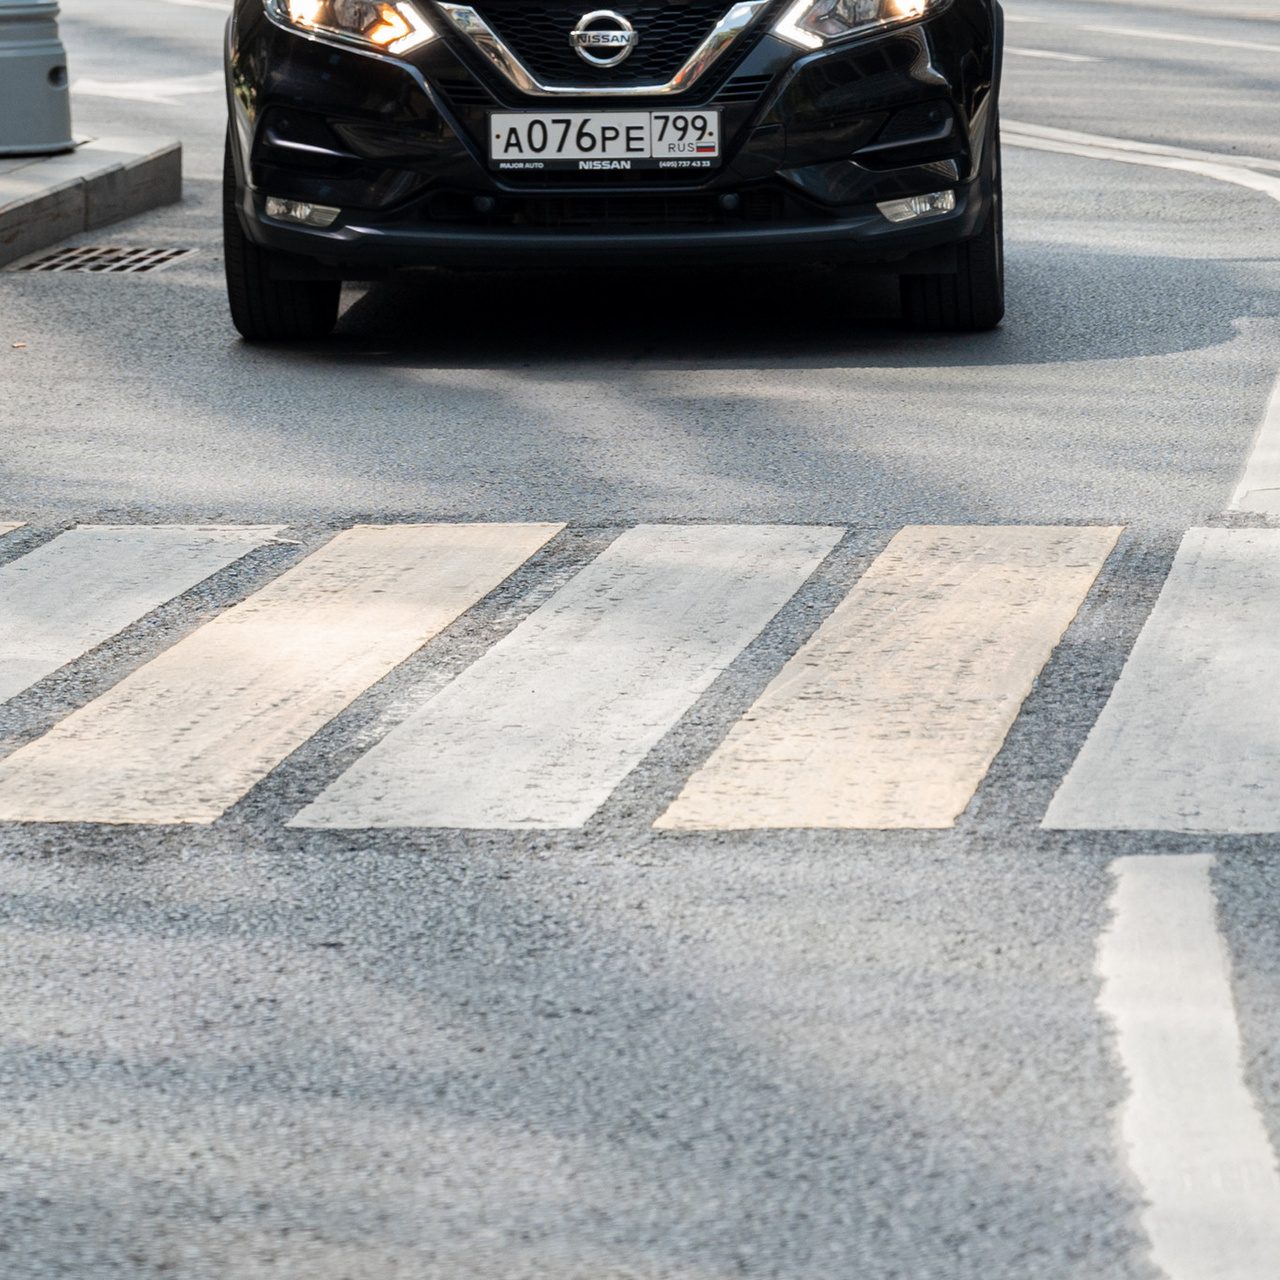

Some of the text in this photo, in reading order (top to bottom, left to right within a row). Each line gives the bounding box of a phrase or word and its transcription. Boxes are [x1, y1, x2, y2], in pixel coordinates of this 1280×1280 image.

[577, 34, 631, 44] NISSAN
[653, 114, 708, 142] 799
[668, 142, 696, 153] RUS
[578, 160, 631, 170] NISSAN
[678, 160, 691, 168] 737
[701, 160, 711, 168] 33
